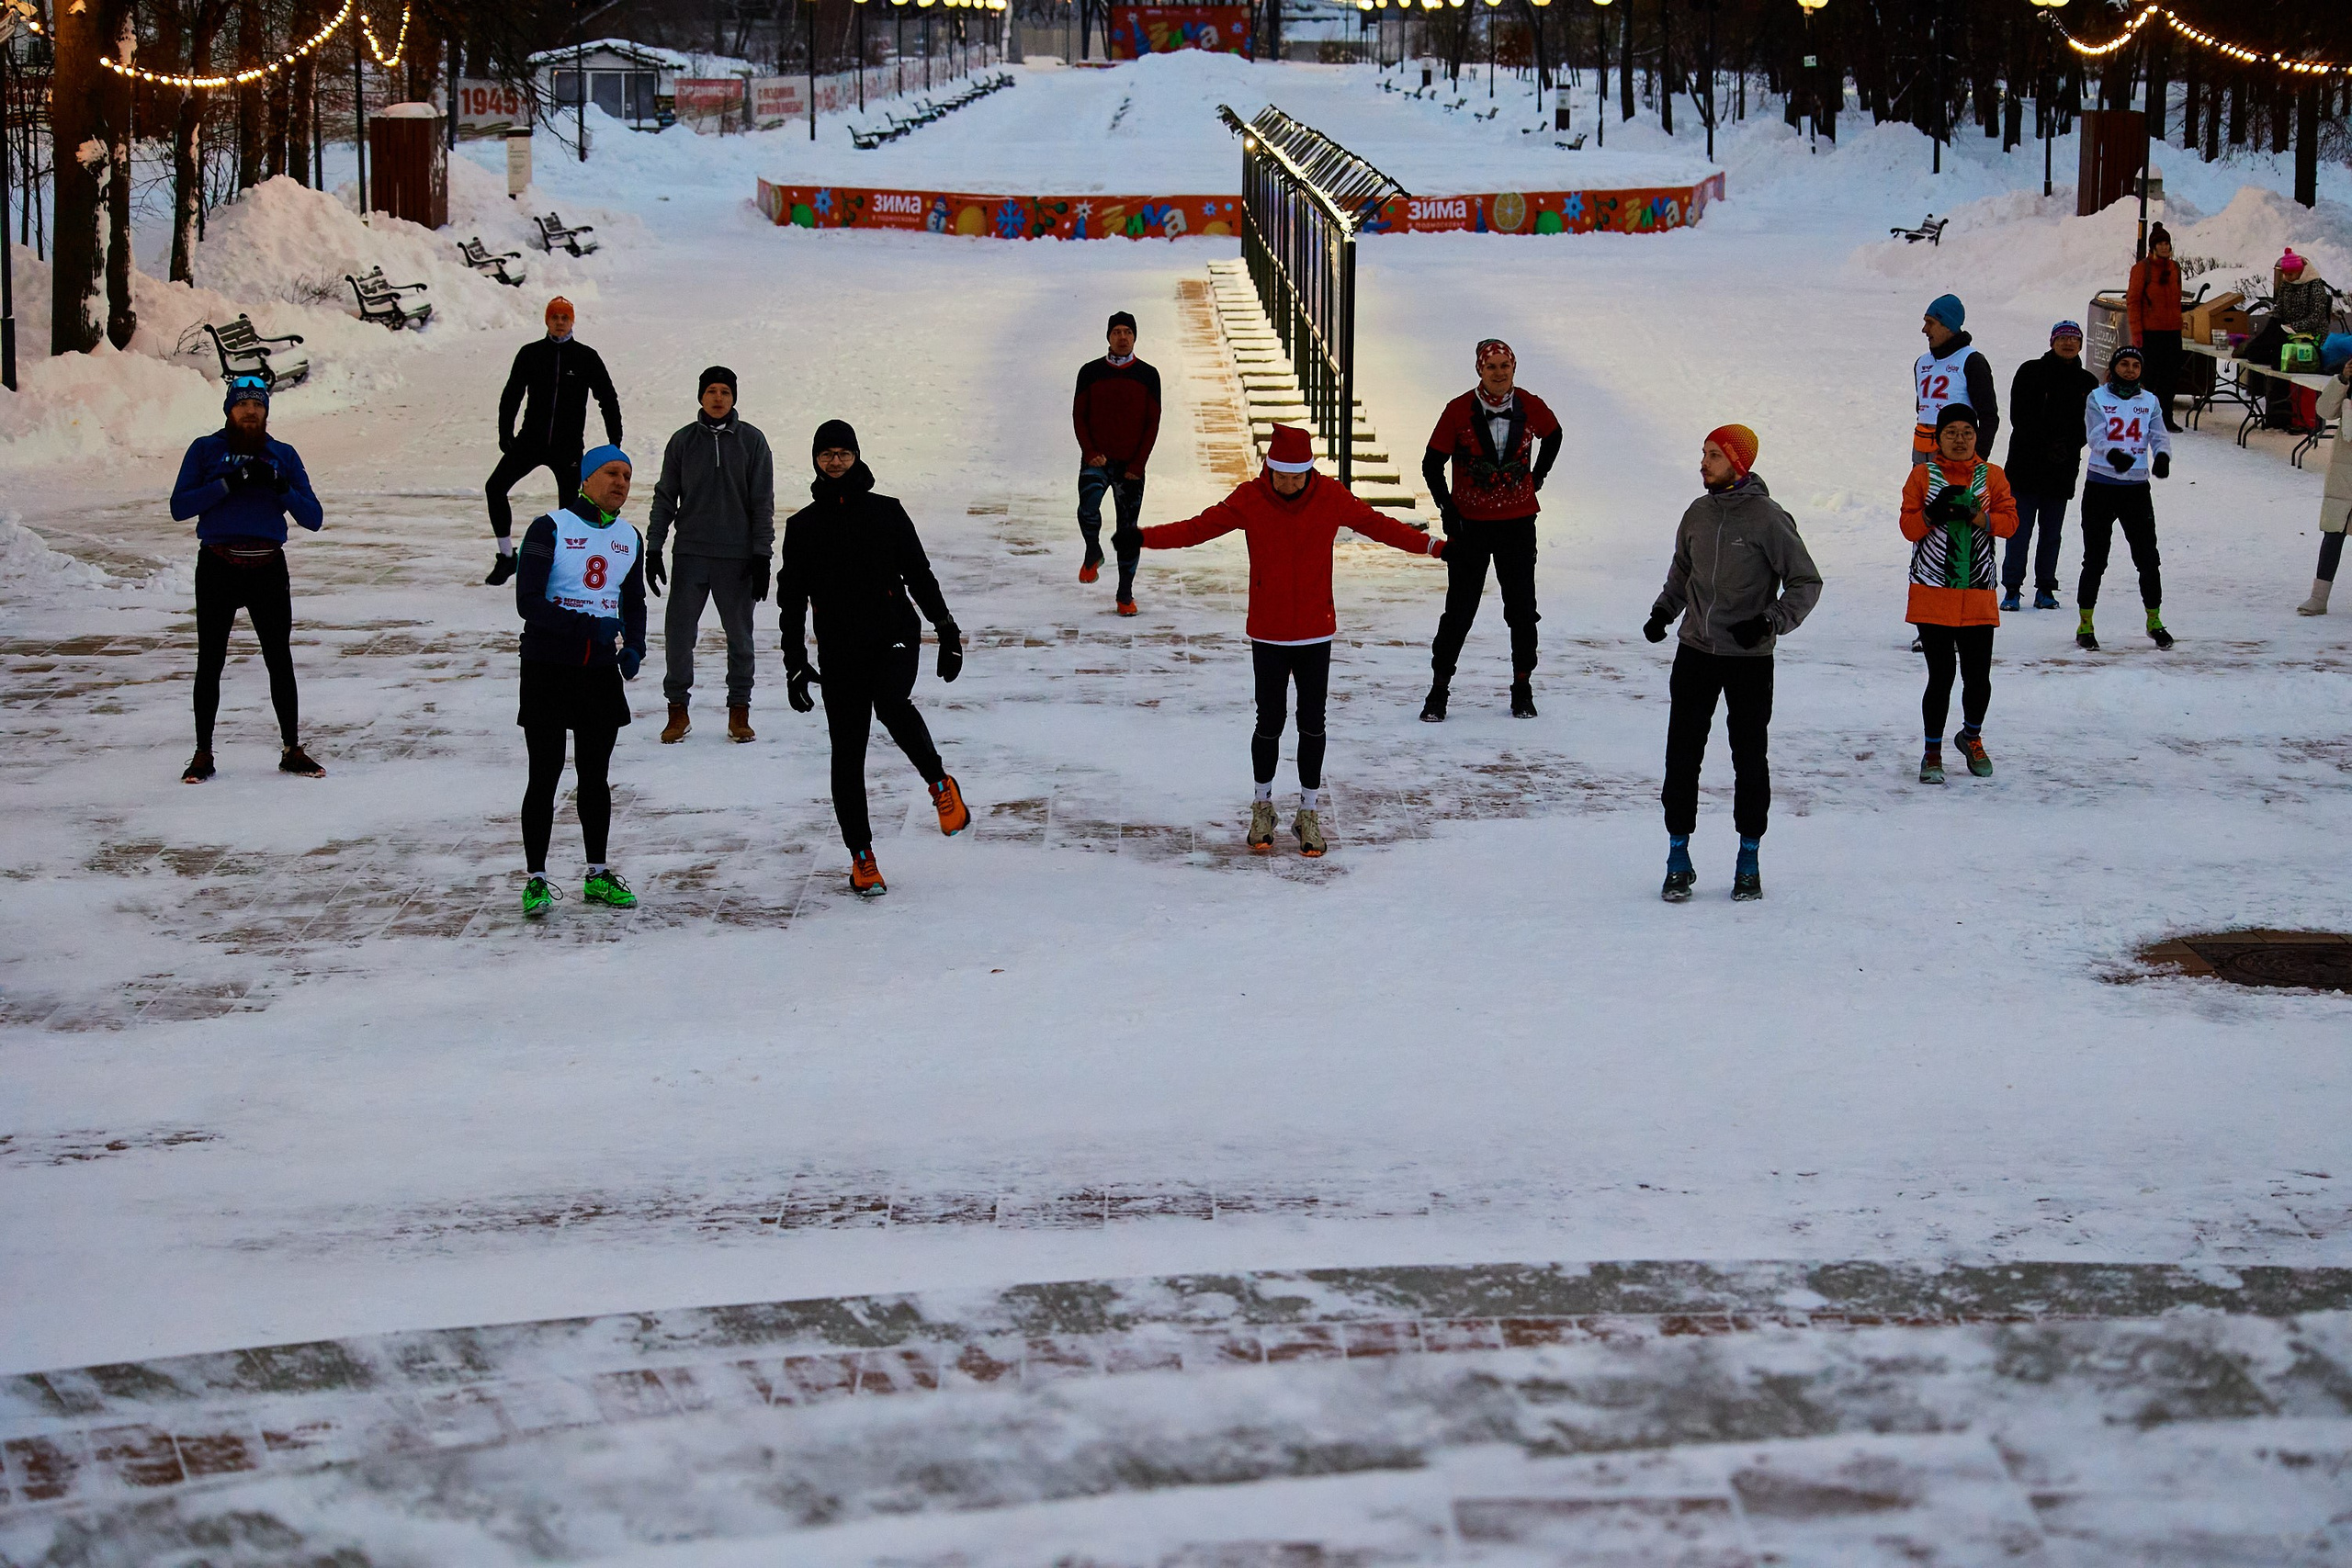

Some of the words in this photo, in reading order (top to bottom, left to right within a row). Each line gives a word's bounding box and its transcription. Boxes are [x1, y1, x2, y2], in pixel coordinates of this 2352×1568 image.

[460, 87, 518, 115] 1945
[1919, 375, 1950, 400] 12
[2108, 417, 2143, 443] 24
[582, 554, 609, 591] 8
